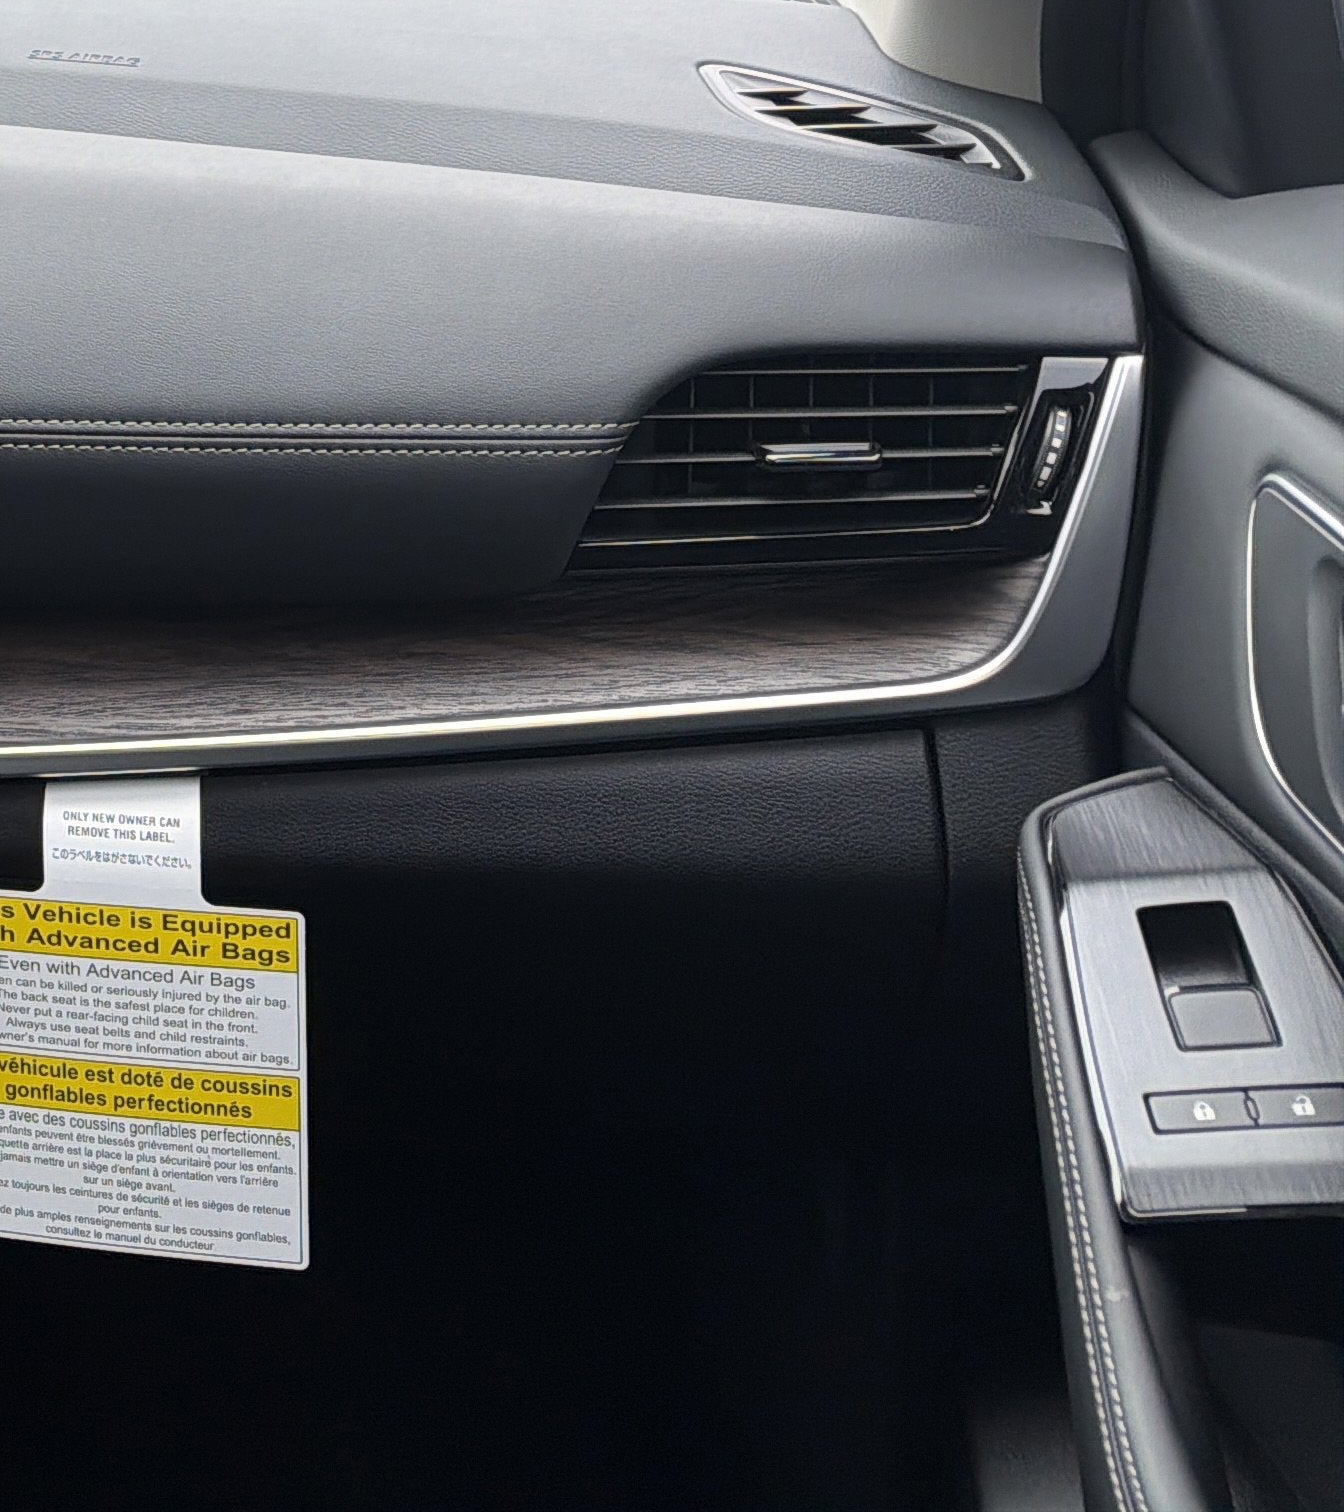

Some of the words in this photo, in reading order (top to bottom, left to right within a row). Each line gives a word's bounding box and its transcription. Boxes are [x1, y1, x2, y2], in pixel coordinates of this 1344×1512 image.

[63, 810, 89, 822] ONLY
[92, 812, 115, 824] NEW
[118, 814, 156, 827] OWNER
[159, 816, 180, 828] CAN
[67, 825, 110, 839] REMOVE
[112, 828, 137, 841] THIS
[139, 830, 175, 844] LABEL.
[22, 902, 121, 927] Vehicle
[130, 911, 152, 930] is
[162, 913, 291, 941] Equipped
[26, 927, 159, 954] Advanced
[170, 939, 211, 957] Air
[222, 942, 290, 967] Bags
[46, 960, 81, 976] with
[86, 963, 174, 984] Advanced
[179, 970, 205, 985] Air
[210, 972, 255, 992] Bags
[15, 978, 37, 988] can
[40, 978, 55, 990] be
[58, 980, 88, 993] killed
[91, 985, 104, 994] or
[106, 985, 159, 1000] seriously
[161, 988, 202, 1002] injured
[205, 992, 220, 1005] by
[223, 993, 242, 1005] the
[245, 995, 261, 1006] air
[264, 996, 290, 1010] bag.
[21, 990, 49, 1003] back
[52, 996, 77, 1006] seat
[80, 996, 90, 1007] is
[92, 997, 112, 1009] the
[114, 1000, 150, 1012] safest
[153, 1002, 185, 1015] place
[188, 1004, 205, 1016] for
[208, 1006, 258, 1019] children.
[5, 1016, 47, 1032] Always
[50, 1023, 72, 1033] use
[74, 1025, 99, 1036] seat
[102, 1026, 131, 1038] belts
[134, 1030, 156, 1040] and
[159, 1031, 187, 1043] child
[190, 1034, 248, 1048] restraints.
[34, 1007, 52, 1018] put
[55, 1010, 63, 1018] a
[66, 1011, 129, 1026] rear-facing
[132, 1015, 160, 1026] child
[162, 1019, 188, 1029] seat
[191, 1019, 202, 1030] in
[205, 1020, 224, 1032] the
[227, 1021, 258, 1034] front.
[37, 1035, 80, 1048] manual
[83, 1038, 99, 1049] for
[102, 1042, 133, 1052] more
[136, 1042, 201, 1058] information
[204, 1048, 239, 1061] about
[242, 1052, 257, 1062] air
[260, 1052, 293, 1066] bags.
[85, 1068, 115, 1084] est
[120, 1068, 164, 1088] doté
[170, 1072, 195, 1091] de
[201, 1079, 292, 1098] coussins
[5, 1084, 107, 1107] gonflables
[113, 1094, 252, 1119] perfectionnés
[9, 1110, 39, 1124] avec
[42, 1111, 66, 1127] des
[69, 1117, 126, 1133] coussins
[129, 1122, 197, 1140] gonflables
[200, 1127, 295, 1150] perfectionnés,
